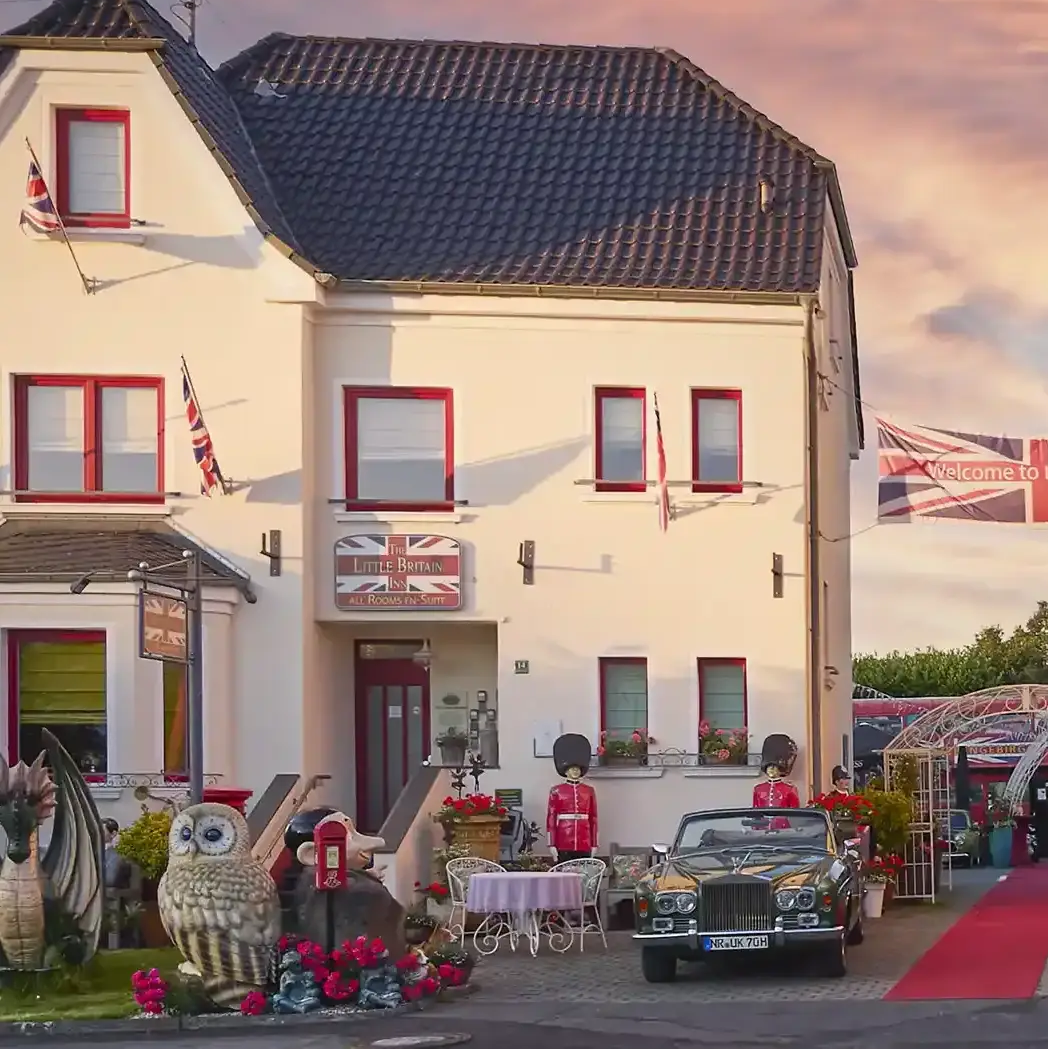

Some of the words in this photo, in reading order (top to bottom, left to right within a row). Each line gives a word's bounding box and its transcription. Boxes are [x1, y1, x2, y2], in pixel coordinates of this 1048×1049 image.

[926, 461, 1015, 481] Welcome
[1019, 464, 1039, 480] to
[969, 745, 1026, 754] NGEBIRG
[710, 939, 724, 949] NR
[730, 937, 744, 948] UK
[747, 937, 767, 948] 70H
